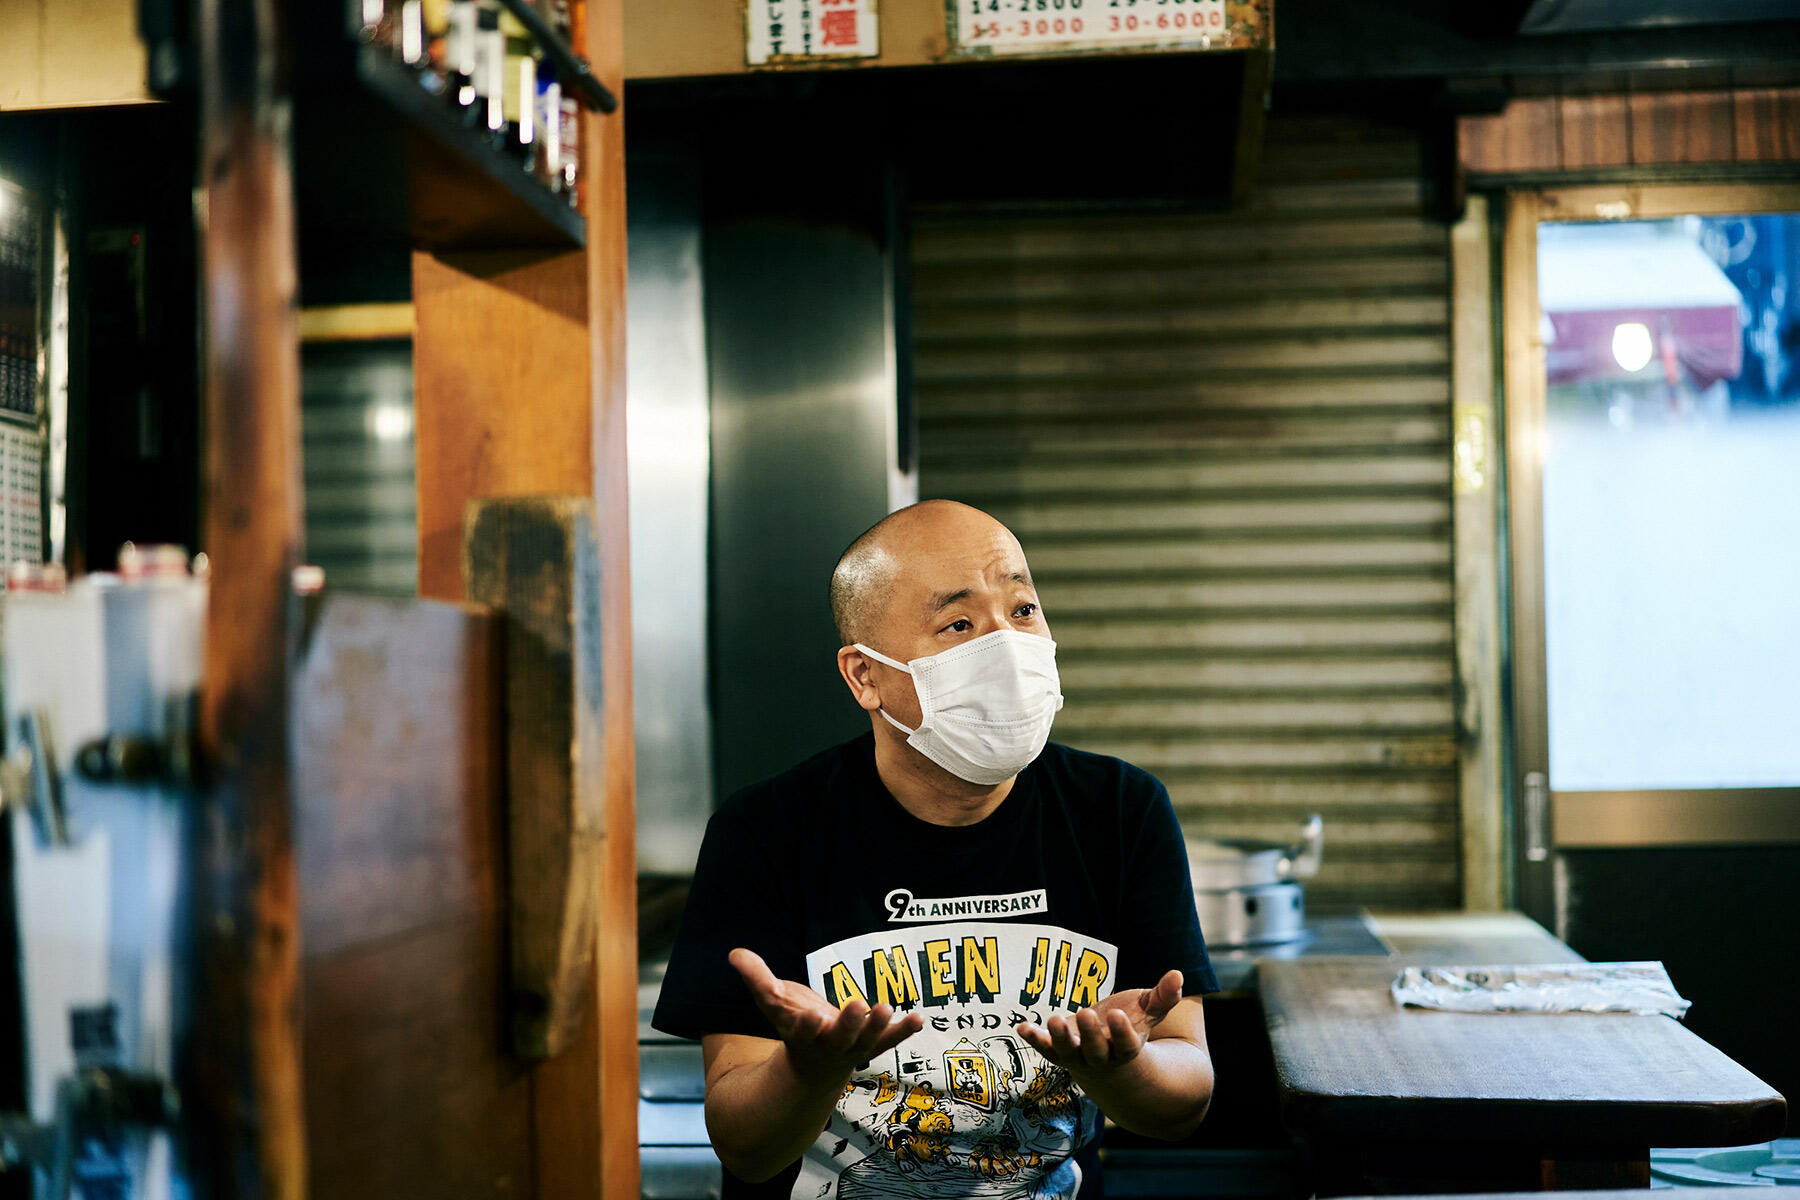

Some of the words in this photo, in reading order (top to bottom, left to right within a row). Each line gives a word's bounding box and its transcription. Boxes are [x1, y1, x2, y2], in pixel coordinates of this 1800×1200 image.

[1109, 11, 1221, 31] 30-6000
[888, 892, 926, 919] 9th
[930, 894, 1042, 917] ANNIVERSARY
